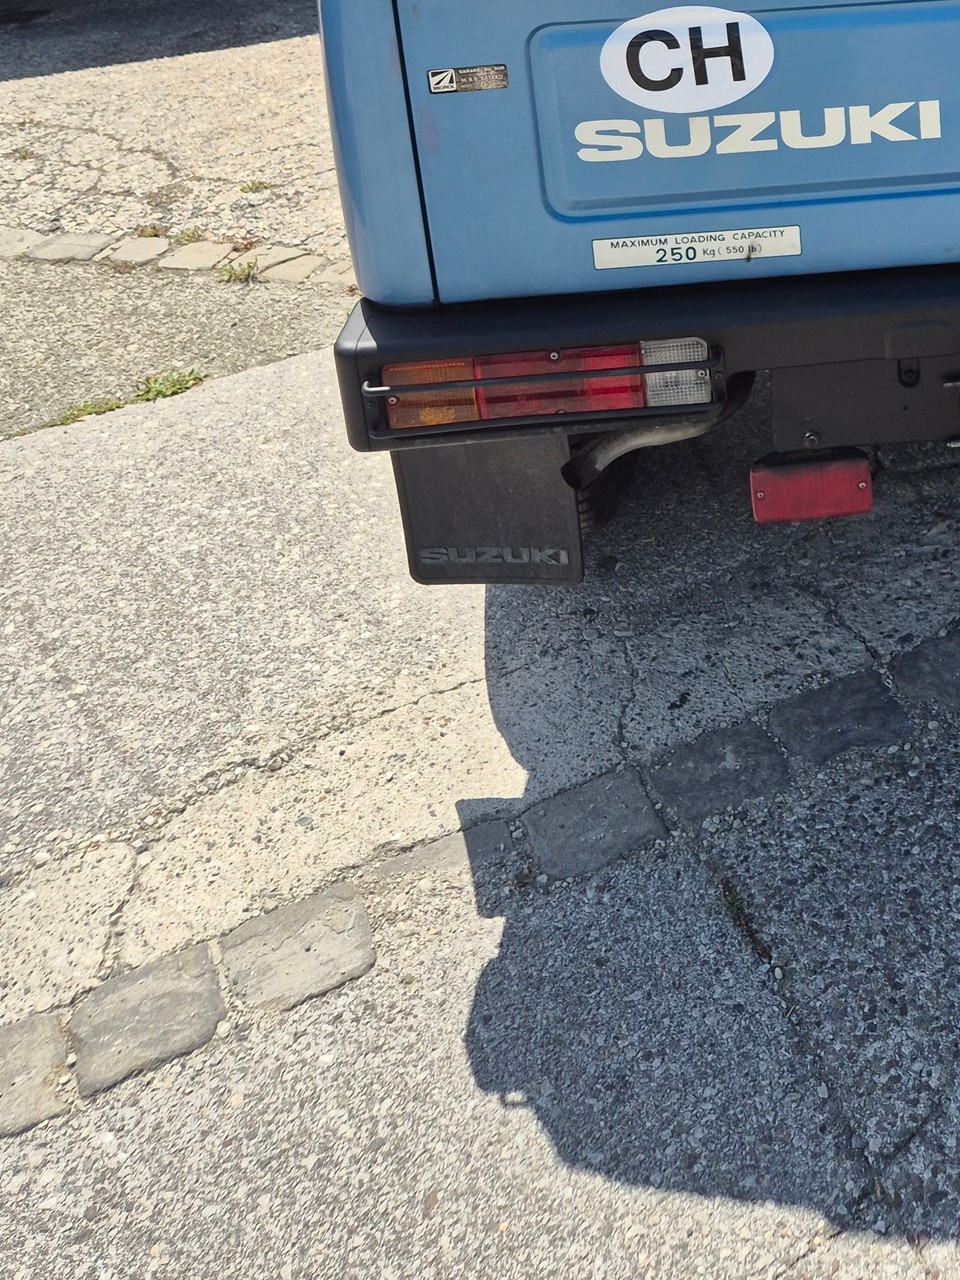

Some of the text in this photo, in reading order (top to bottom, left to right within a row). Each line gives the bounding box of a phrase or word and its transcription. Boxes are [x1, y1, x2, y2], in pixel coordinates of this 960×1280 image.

[625, 22, 747, 92] CH
[574, 100, 942, 162] SUZUKI
[610, 229, 785, 249] MAXIMUM LOADING CAPACITY
[656, 246, 697, 263] 250
[726, 246, 744, 254] 550
[420, 546, 569, 566] SUZUKI
